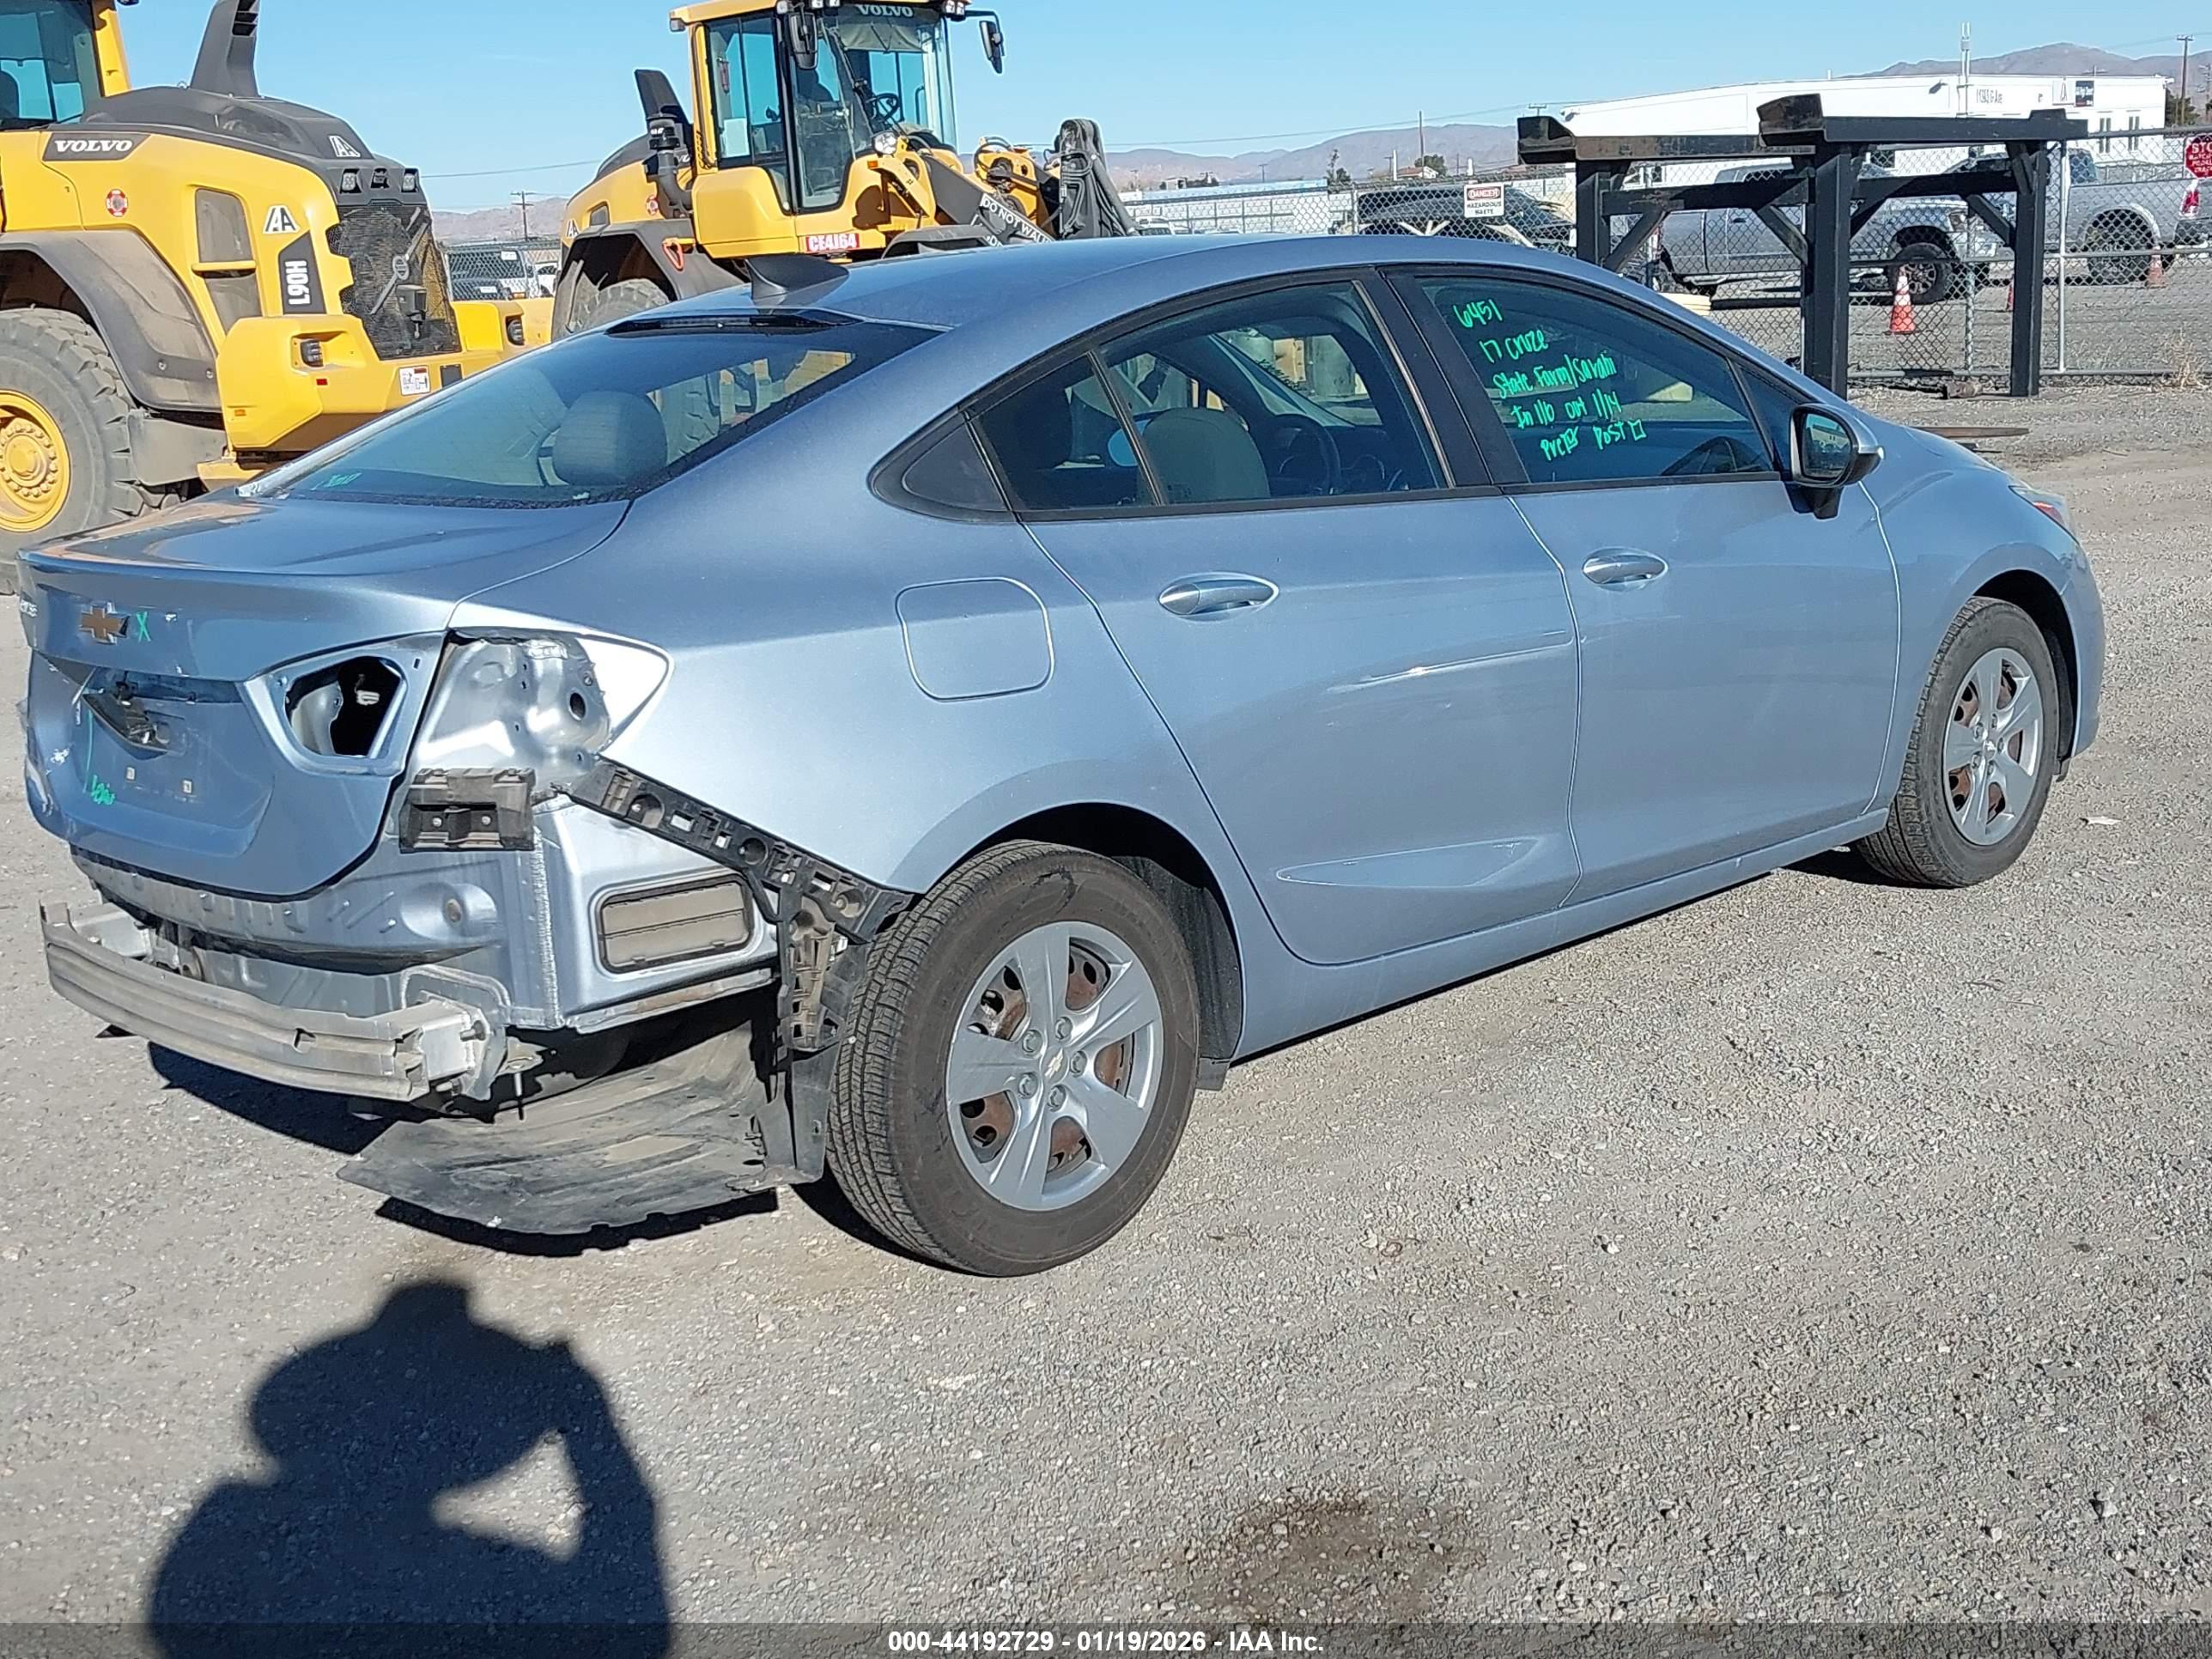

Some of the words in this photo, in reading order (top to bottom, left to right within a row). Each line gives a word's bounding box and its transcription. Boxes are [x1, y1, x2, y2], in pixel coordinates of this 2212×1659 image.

[855, 4, 913, 17] VOLVO
[55, 140, 132, 152] VOLVO
[1468, 189, 1499, 198] DANGER
[981, 198, 997, 212] DO
[998, 209, 1020, 228] NOT
[284, 260, 311, 305] L90H
[1453, 300, 1502, 327] 6451
[1479, 339, 1502, 364] 17
[1493, 371, 1534, 398] State
[1511, 404, 1534, 428] In
[1565, 397, 1587, 419] out
